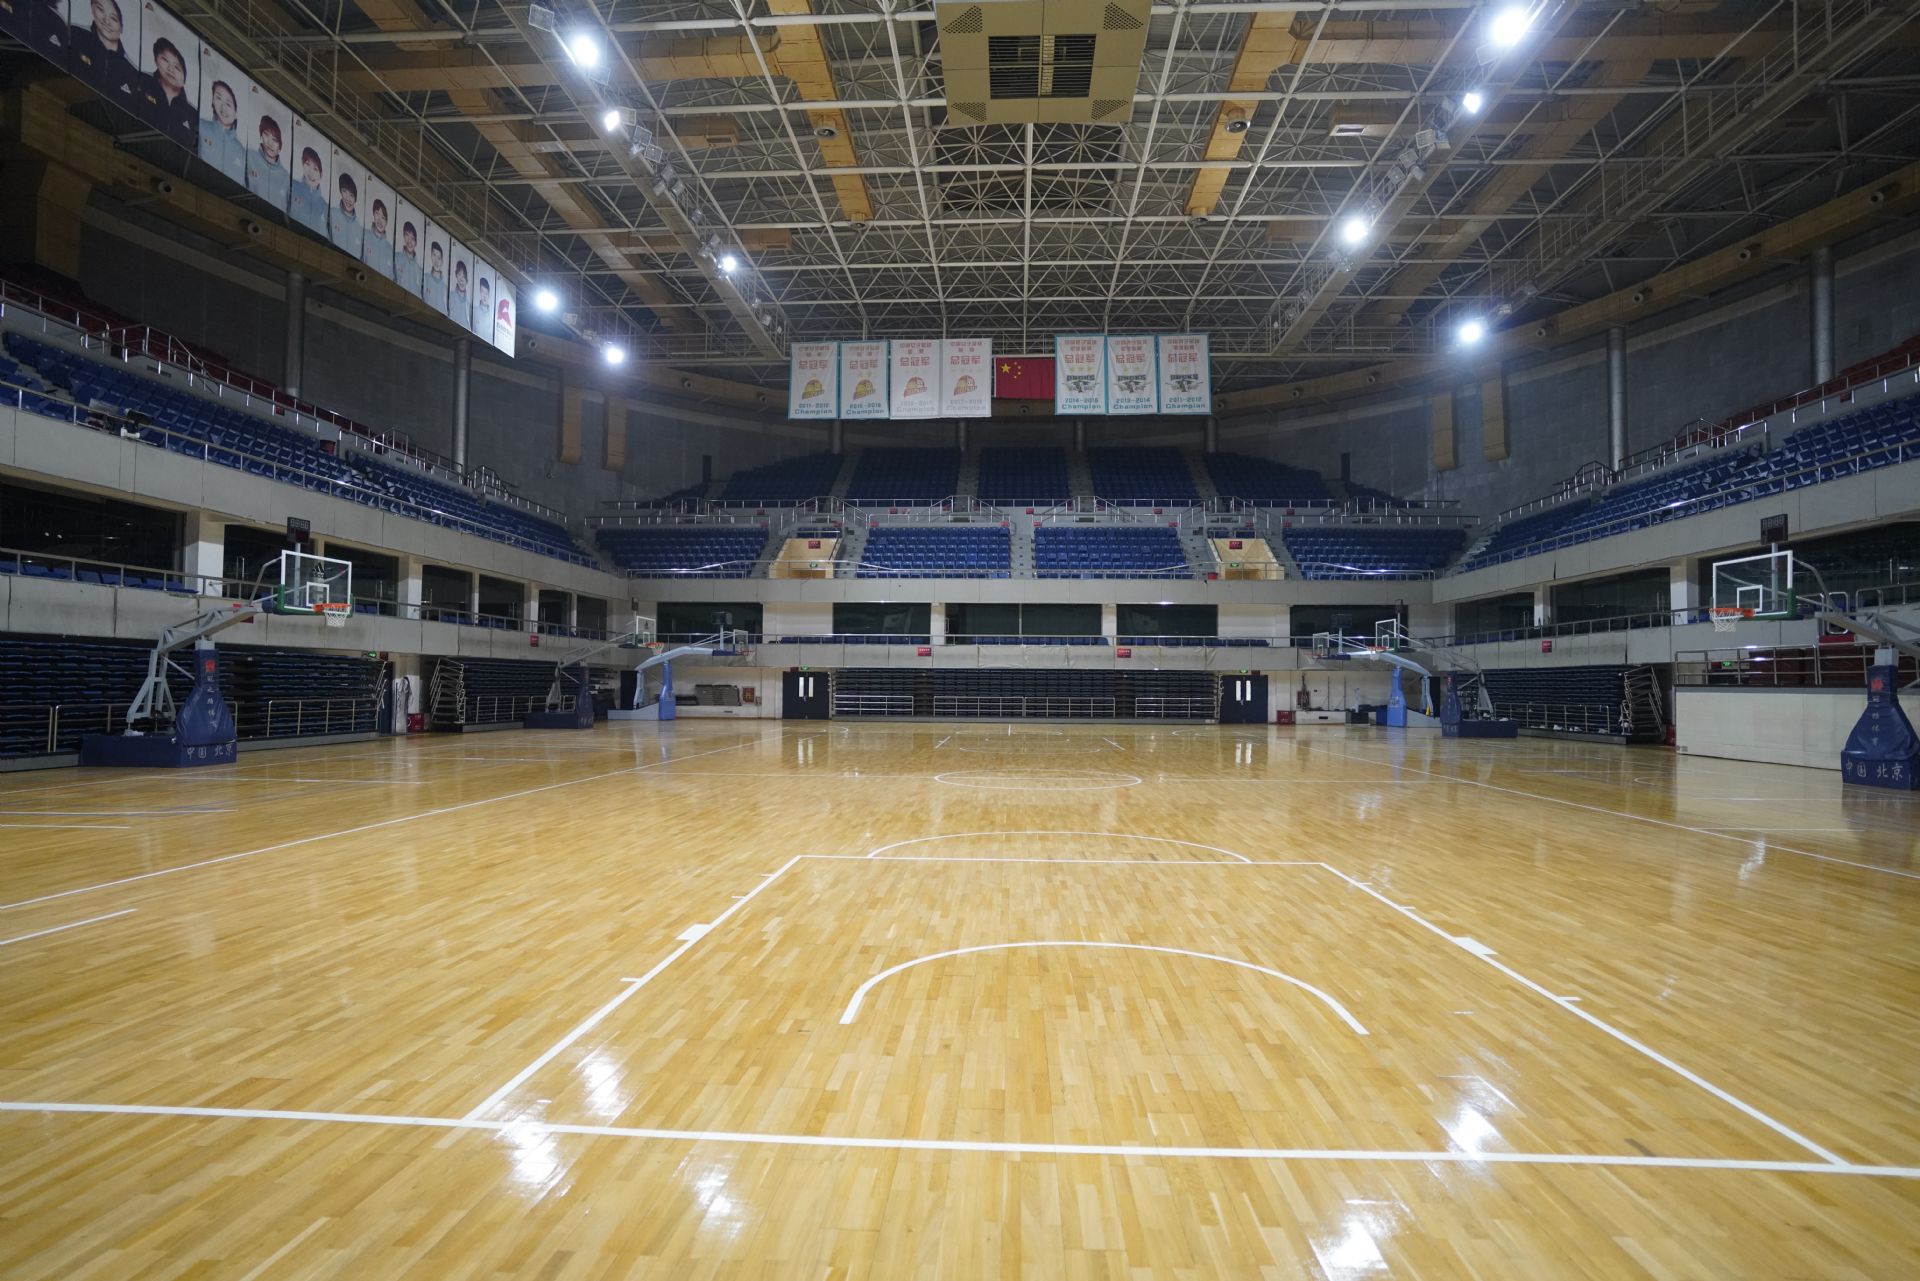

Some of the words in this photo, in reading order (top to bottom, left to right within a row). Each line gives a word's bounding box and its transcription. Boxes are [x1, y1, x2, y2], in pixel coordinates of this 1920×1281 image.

[900, 356, 930, 366] 总冠军
[950, 355, 980, 365] 总冠军
[1168, 353, 1198, 363] 总冠军
[187, 747, 207, 759] 中国
[214, 744, 233, 757] 北京
[1846, 760, 1866, 777] 中国
[1876, 764, 1904, 781] 北京
